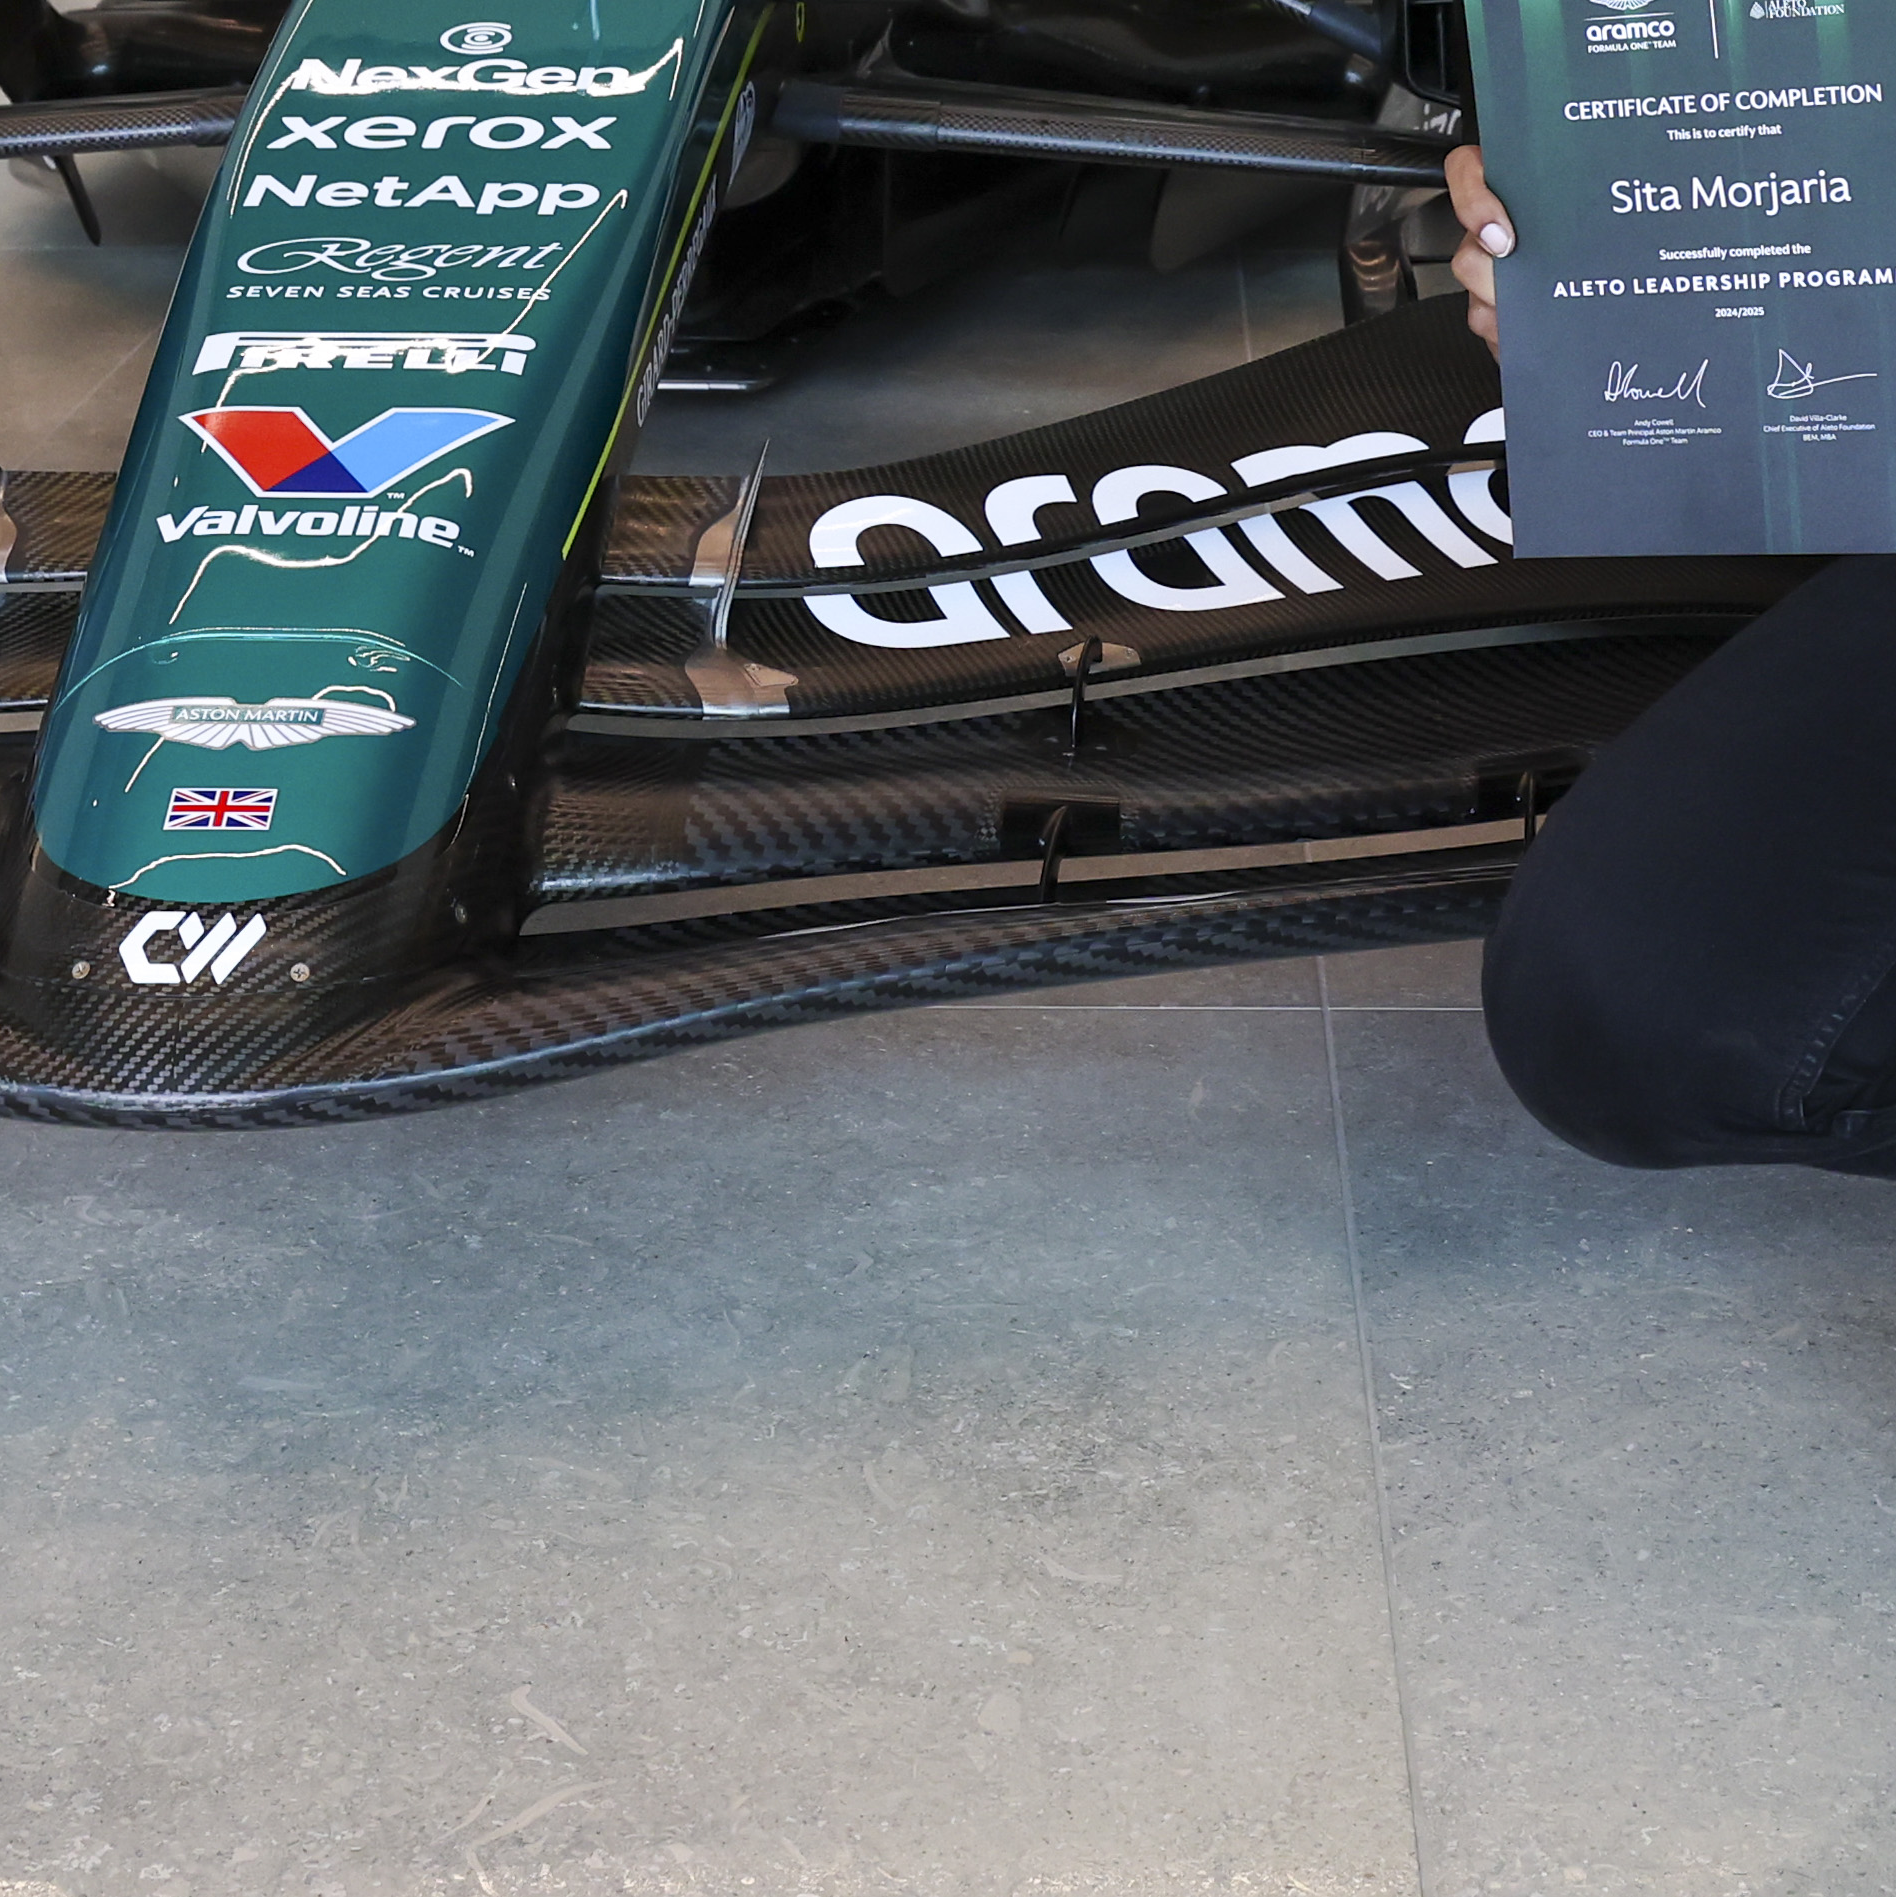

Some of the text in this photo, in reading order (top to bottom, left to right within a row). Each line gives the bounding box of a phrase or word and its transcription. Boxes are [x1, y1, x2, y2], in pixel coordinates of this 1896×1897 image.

[1768, 4, 1845, 19] FOUNDATION
[1586, 19, 1675, 42] aramco
[1587, 42, 1629, 54] FORMULA
[1653, 39, 1677, 49] TEAM
[291, 58, 637, 96] NexGen
[1563, 83, 1883, 121] CERTIFICATE OF COMPLETION
[266, 116, 618, 150] xerox
[1666, 123, 1783, 141] This is to certify that
[242, 174, 601, 216] NetApp
[1610, 169, 1852, 216] Sita Morjaria
[237, 237, 564, 282] Regent
[1659, 243, 1812, 261] Successfully completed the
[226, 286, 551, 301] SEVEN SEAS CRUISES
[1553, 278, 1626, 298] ALETO
[1633, 273, 1771, 295] LEADERSHIP
[1715, 307, 1765, 318] 2024/2025
[156, 504, 460, 548] Valvoline
[803, 407, 1514, 649] aram
[175, 708, 318, 723] ASTON MARTIN
